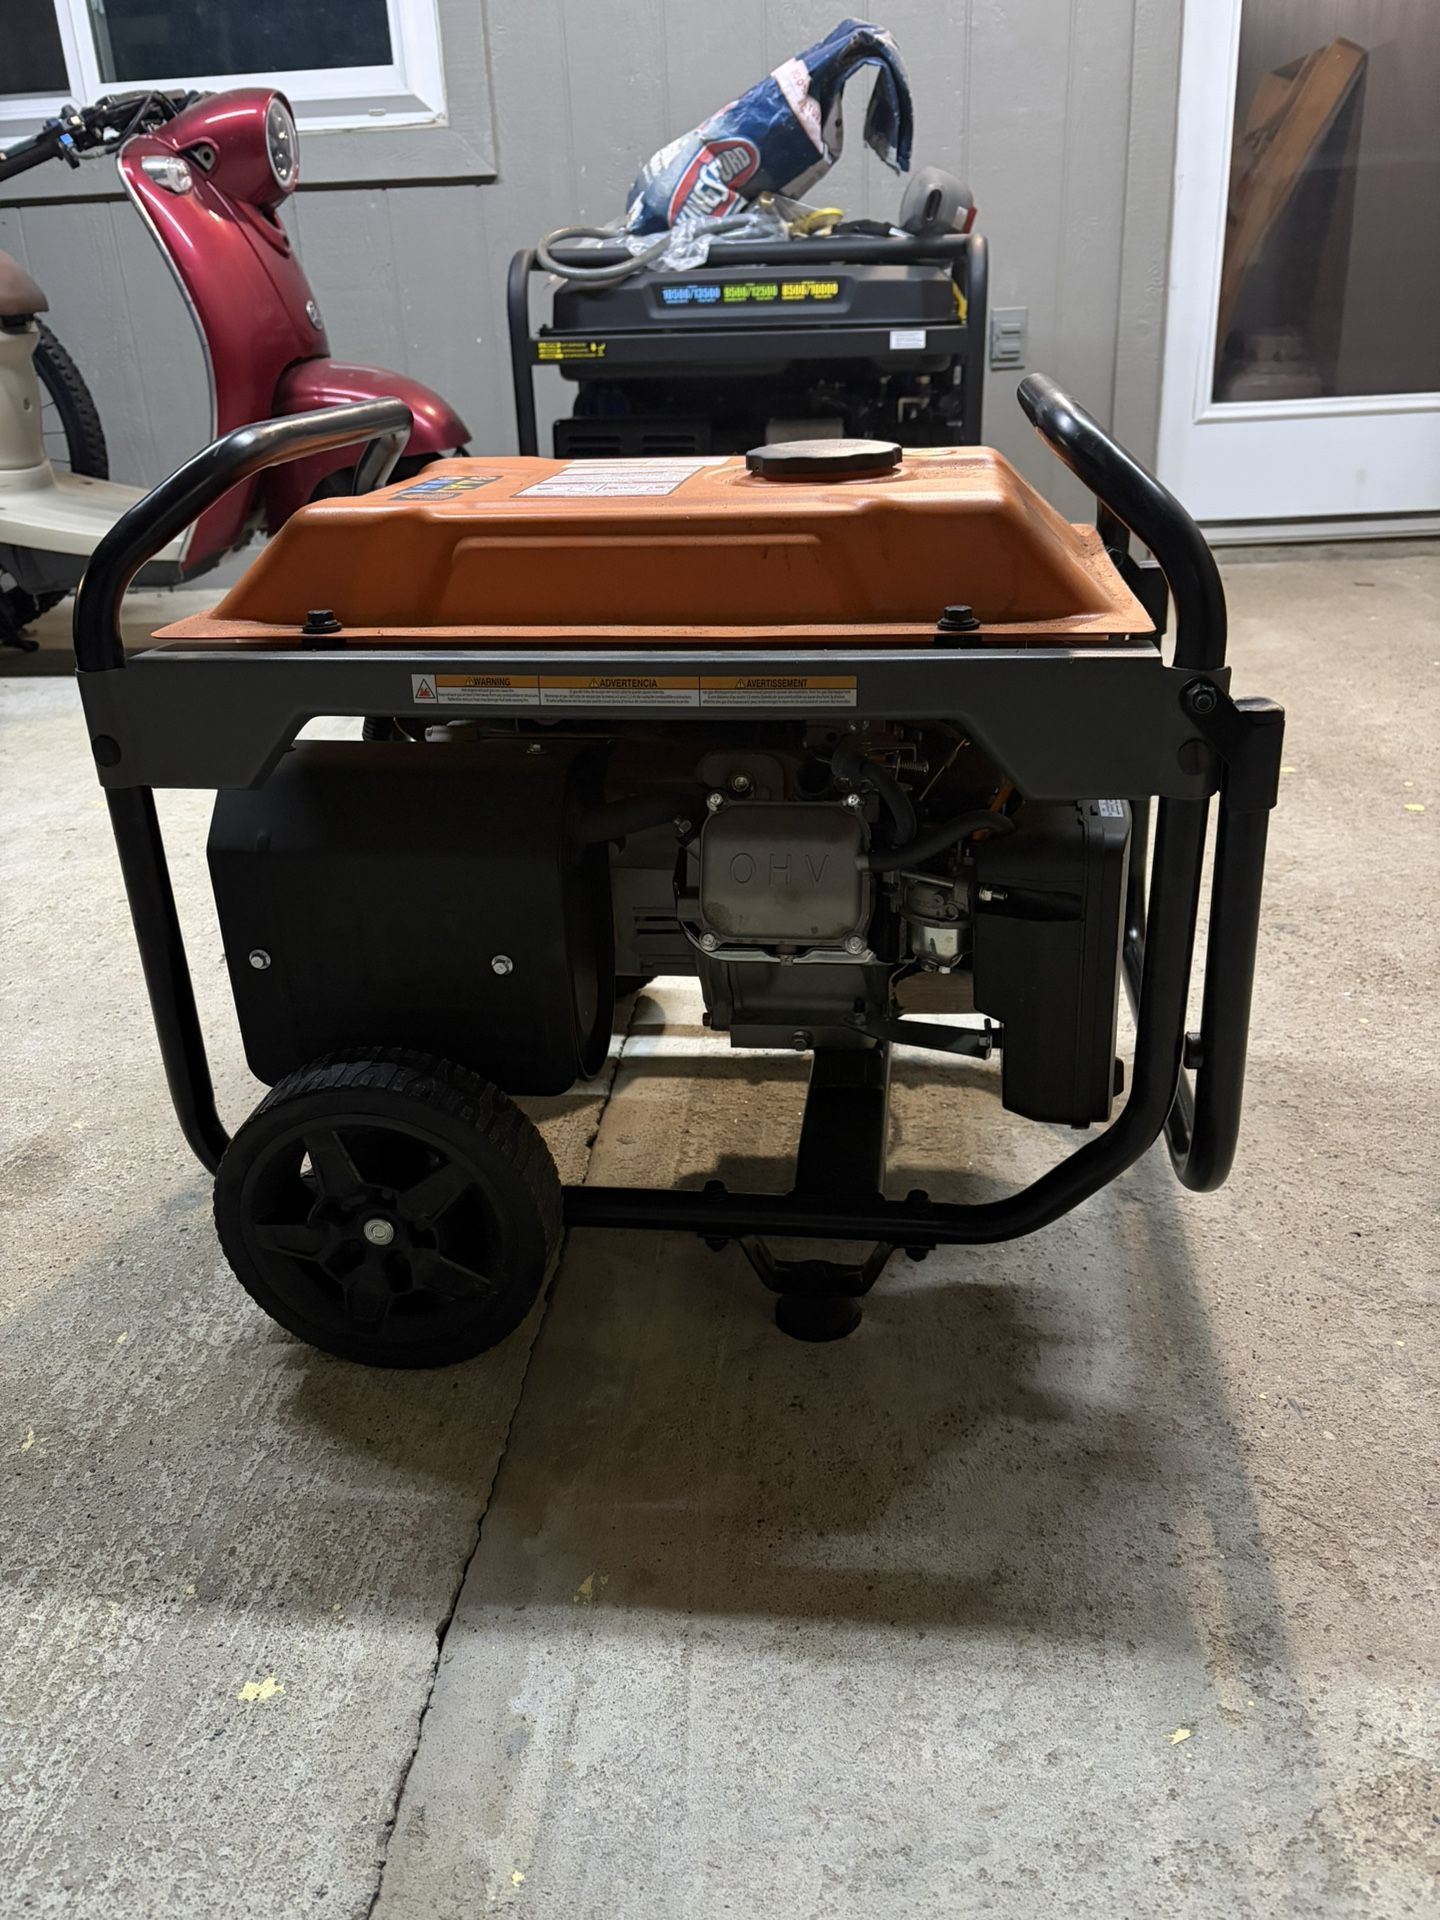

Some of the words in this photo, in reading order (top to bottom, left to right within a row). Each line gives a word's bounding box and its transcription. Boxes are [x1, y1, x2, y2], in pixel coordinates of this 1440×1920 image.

[474, 677, 511, 686] WARNING
[600, 678, 658, 688] ADVERTENCIA
[746, 678, 808, 688] AVERTISSEMENT
[730, 852, 829, 886] OHV
